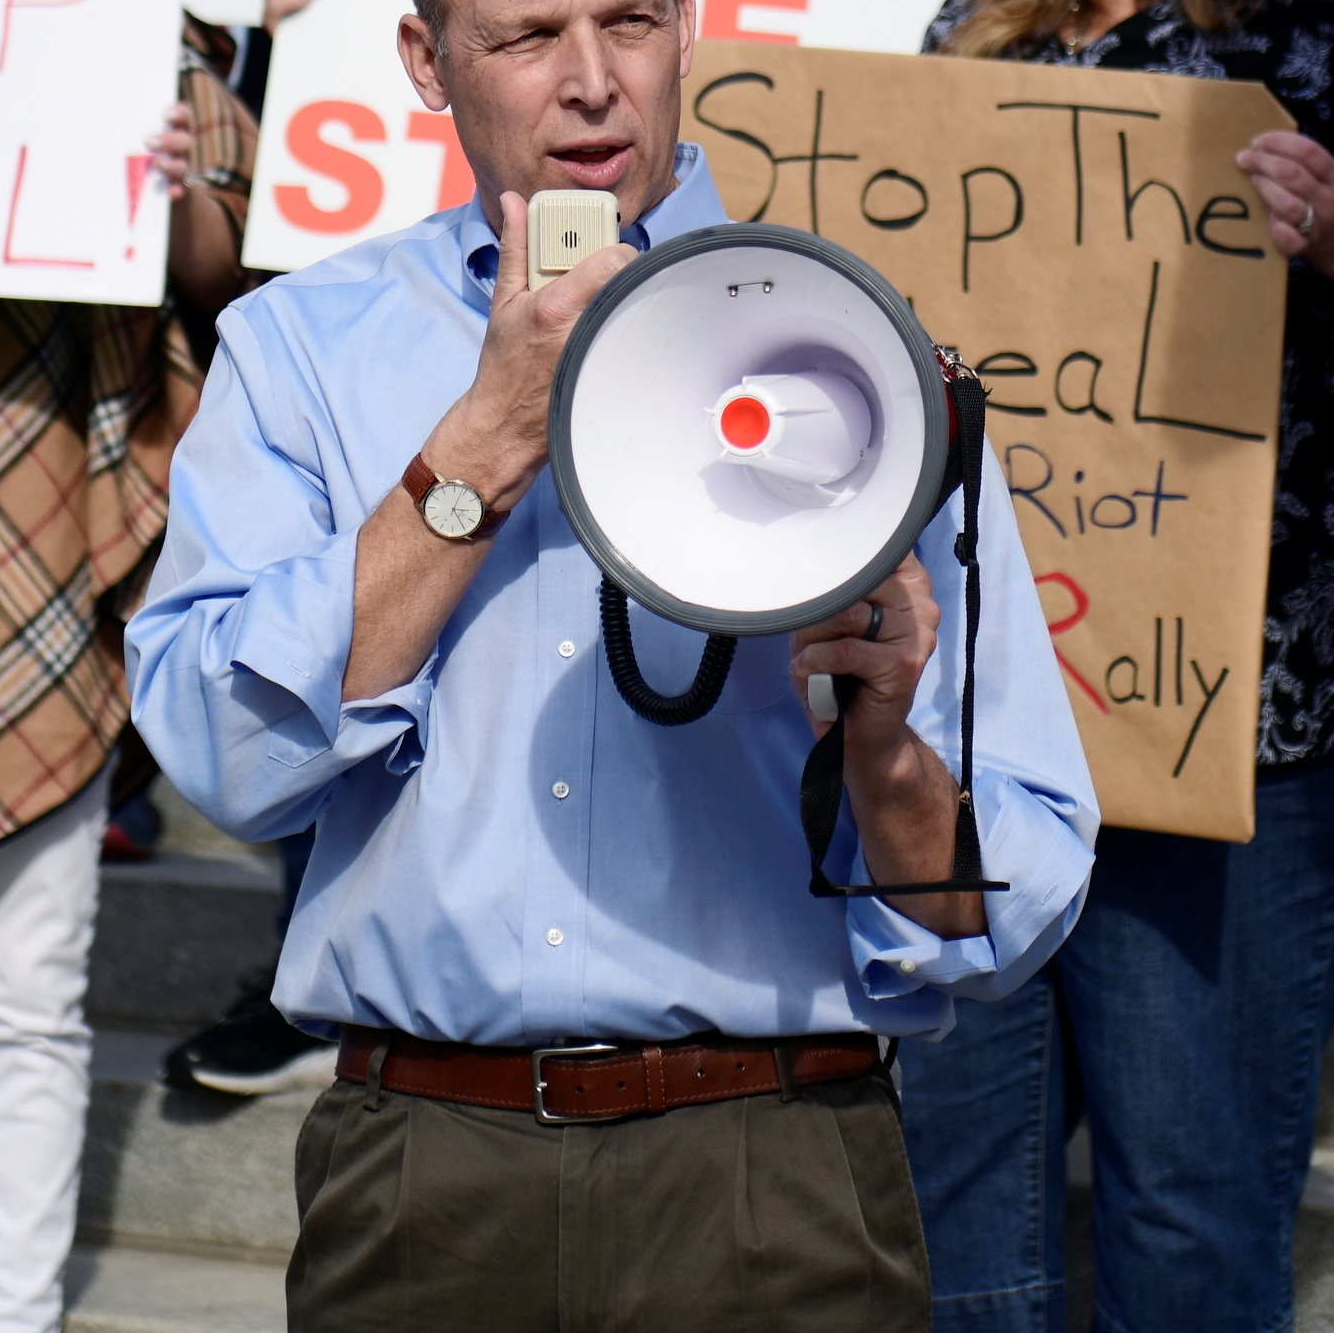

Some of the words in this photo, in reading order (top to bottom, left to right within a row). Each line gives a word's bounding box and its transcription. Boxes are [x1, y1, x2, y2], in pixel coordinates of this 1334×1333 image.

[693, 72, 1025, 292] Stop
[997, 102, 1267, 260] The
[1005, 444, 1189, 539] Riot
